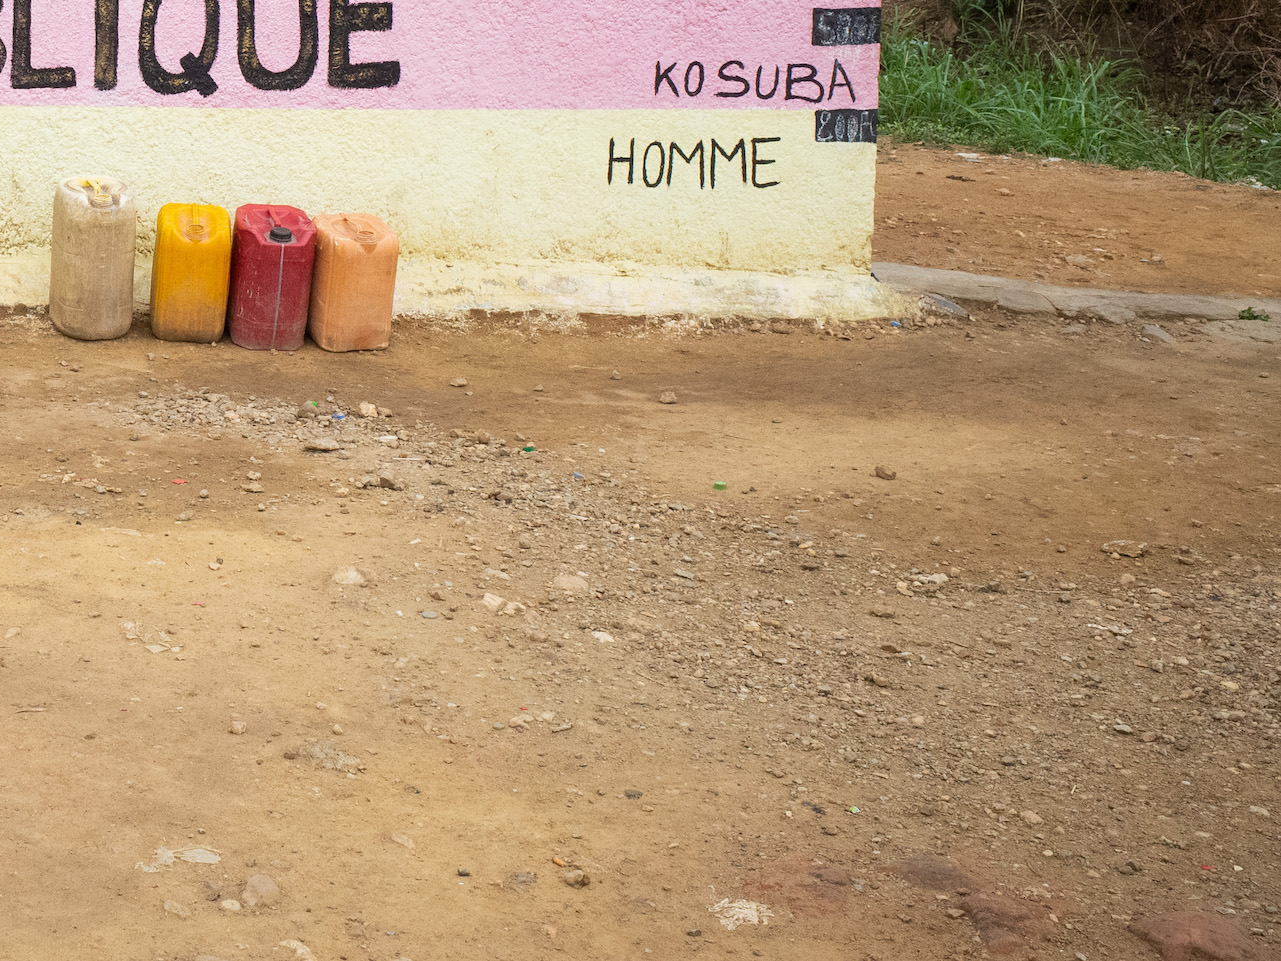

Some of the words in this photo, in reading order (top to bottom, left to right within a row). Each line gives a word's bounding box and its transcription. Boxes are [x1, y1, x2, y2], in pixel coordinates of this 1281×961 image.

[654, 59, 705, 98] KO
[713, 58, 856, 103] SUBA
[607, 136, 782, 190] HOMME
